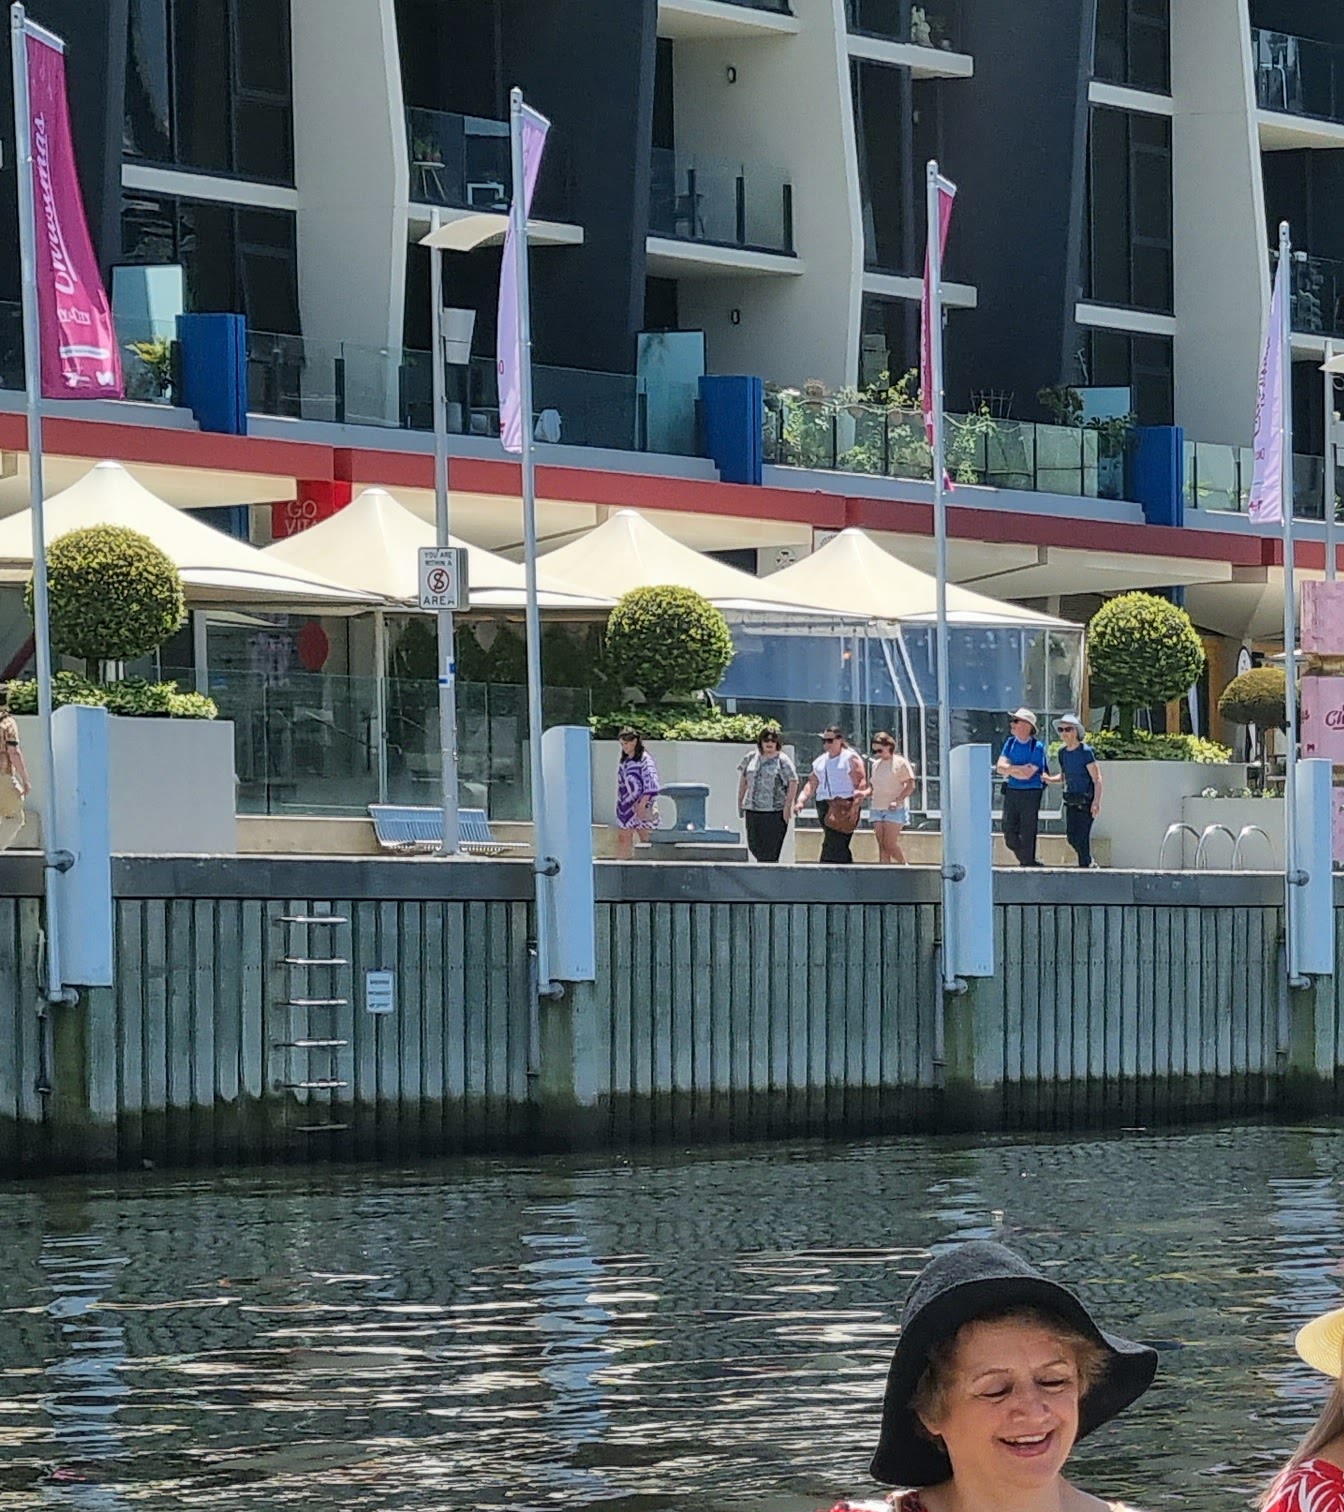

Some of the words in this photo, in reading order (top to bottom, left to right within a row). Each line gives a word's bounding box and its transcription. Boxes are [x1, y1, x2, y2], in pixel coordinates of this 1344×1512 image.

[287, 500, 317, 518] GO
[424, 551, 438, 559] YOU
[440, 551, 452, 559] ARE
